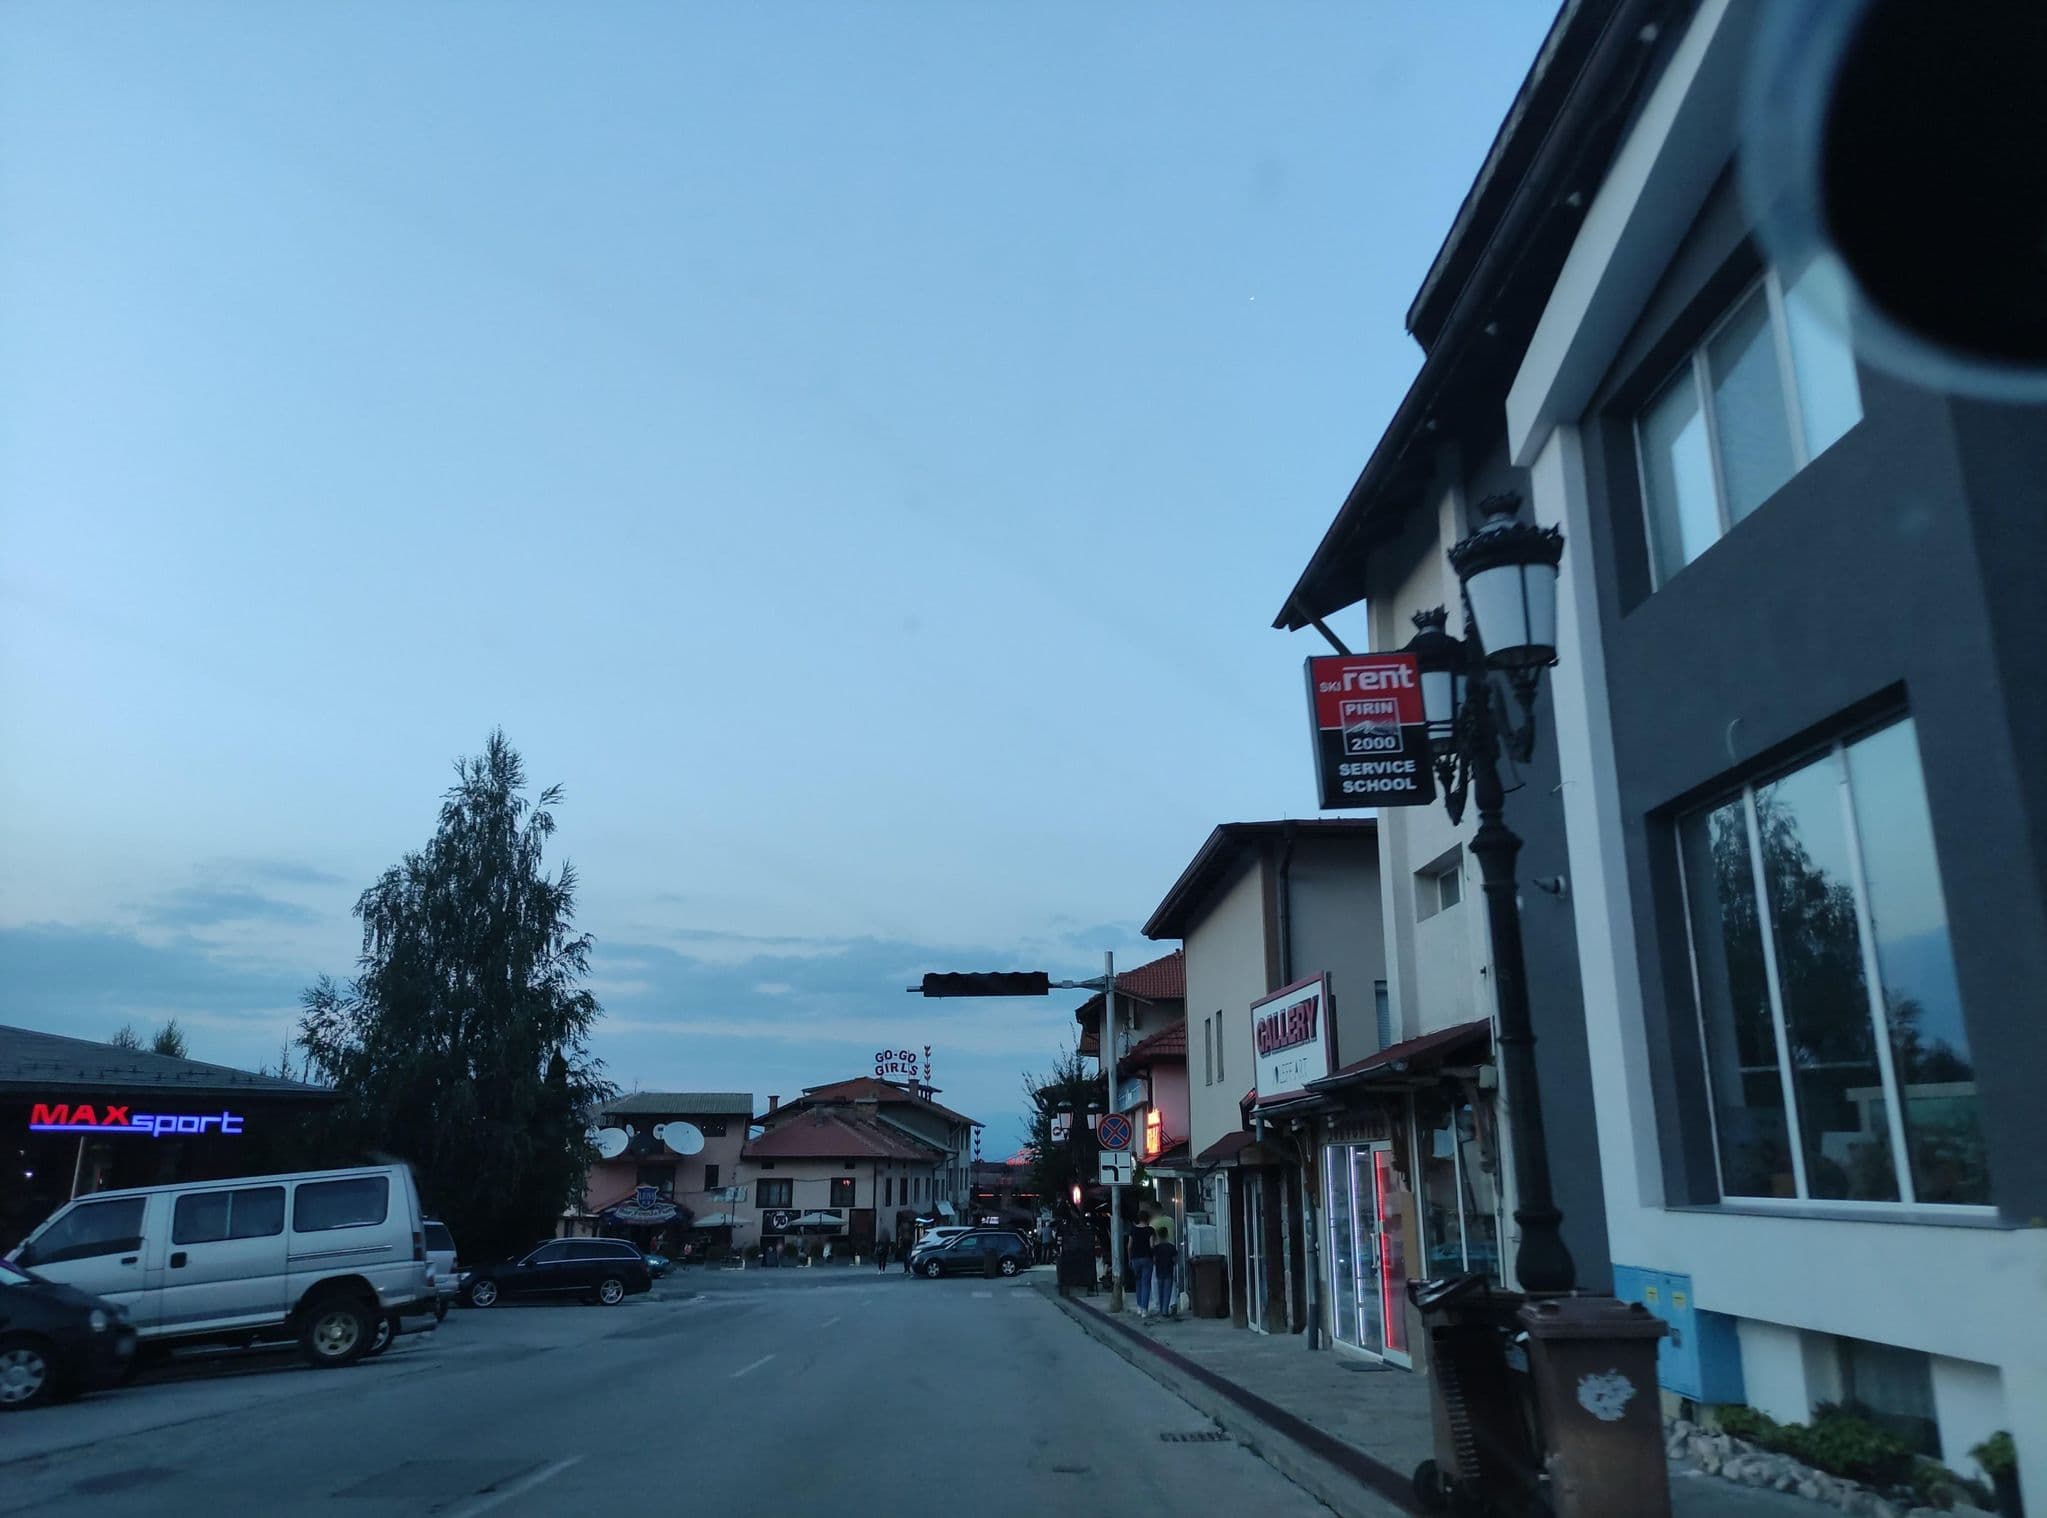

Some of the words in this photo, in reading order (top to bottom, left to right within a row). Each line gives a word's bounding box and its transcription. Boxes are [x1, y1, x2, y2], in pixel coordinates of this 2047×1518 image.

[1343, 663, 1415, 692] rent
[1344, 701, 1394, 716] PIRIN
[1351, 736, 1397, 751] 2000
[1339, 760, 1417, 777] SERVICE
[1342, 778, 1418, 794] SCHOOL
[1256, 994, 1320, 1058] GALLERY
[875, 1050, 917, 1063] GO-GO
[875, 1062, 919, 1076] GIRLS
